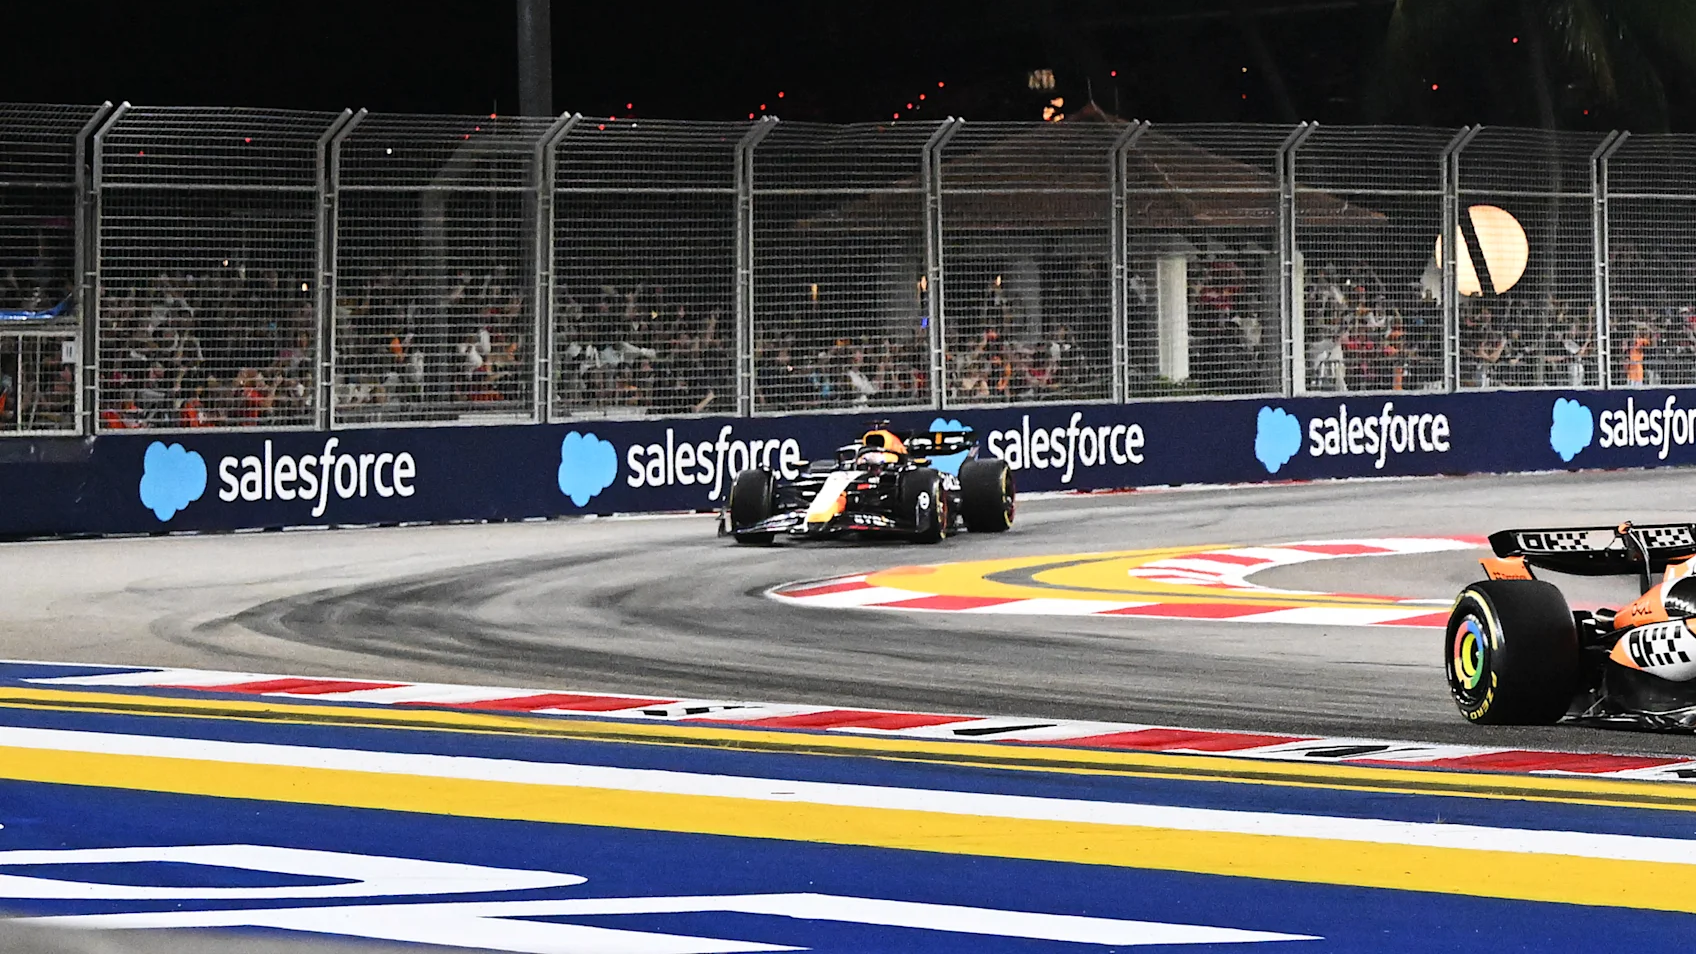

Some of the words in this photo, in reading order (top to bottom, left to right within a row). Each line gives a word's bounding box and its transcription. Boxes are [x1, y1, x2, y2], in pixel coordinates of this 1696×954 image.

[627, 425, 800, 501] salesforce
[987, 411, 1145, 483] salesforce
[1309, 402, 1450, 469] salesforce
[219, 439, 416, 517] salesforce
